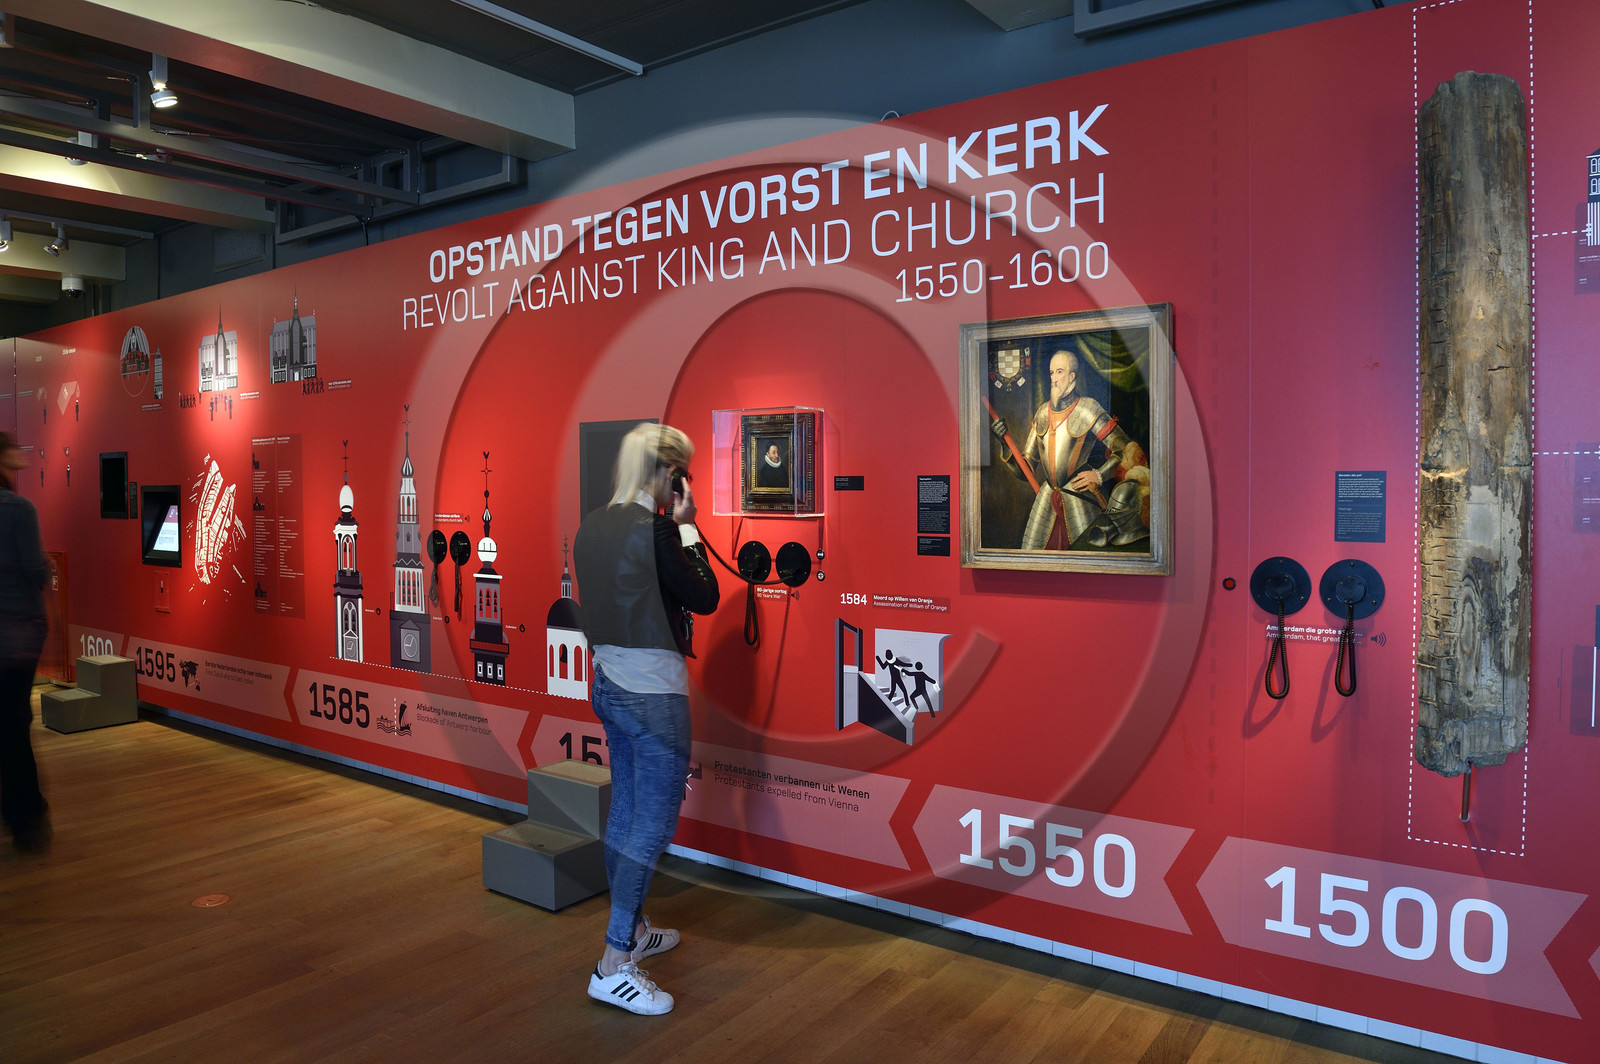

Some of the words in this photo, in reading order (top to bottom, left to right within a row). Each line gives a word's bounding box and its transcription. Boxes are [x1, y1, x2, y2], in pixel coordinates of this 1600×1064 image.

[429, 222, 564, 284] OPSTAND
[572, 194, 689, 255] TEGEN
[700, 160, 849, 228] VORST
[864, 142, 928, 200] EN
[948, 104, 1110, 185] KERK
[403, 281, 503, 331] REVOLT
[507, 254, 649, 314] AGAINST
[658, 237, 744, 290] KING
[759, 218, 851, 275] AND
[870, 172, 1106, 257] CHURCH
[895, 241, 1109, 304] 1550-1600
[840, 593, 868, 605] 1584
[80, 634, 114, 658] 1600
[1317, 627, 1337, 635] grote
[136, 646, 176, 683] 1595
[309, 682, 370, 729] 1585
[416, 703, 441, 716] Afsluiting
[441, 708, 457, 718] haven
[458, 711, 488, 724] Antwerpen
[416, 713, 440, 725] Blockade
[440, 718, 446, 726] of
[446, 720, 469, 731] Antwerp
[469, 724, 492, 736] harbour
[714, 760, 772, 780] Protestanten
[773, 772, 821, 791] verbannen
[822, 778, 836, 792] uit
[838, 784, 870, 800] Wenen
[714, 773, 765, 794] Protestants
[767, 784, 802, 802] expelled
[804, 790, 827, 806] from
[827, 795, 859, 812] Vienna
[958, 808, 1136, 898] 1550
[1264, 865, 1509, 976] 1500
